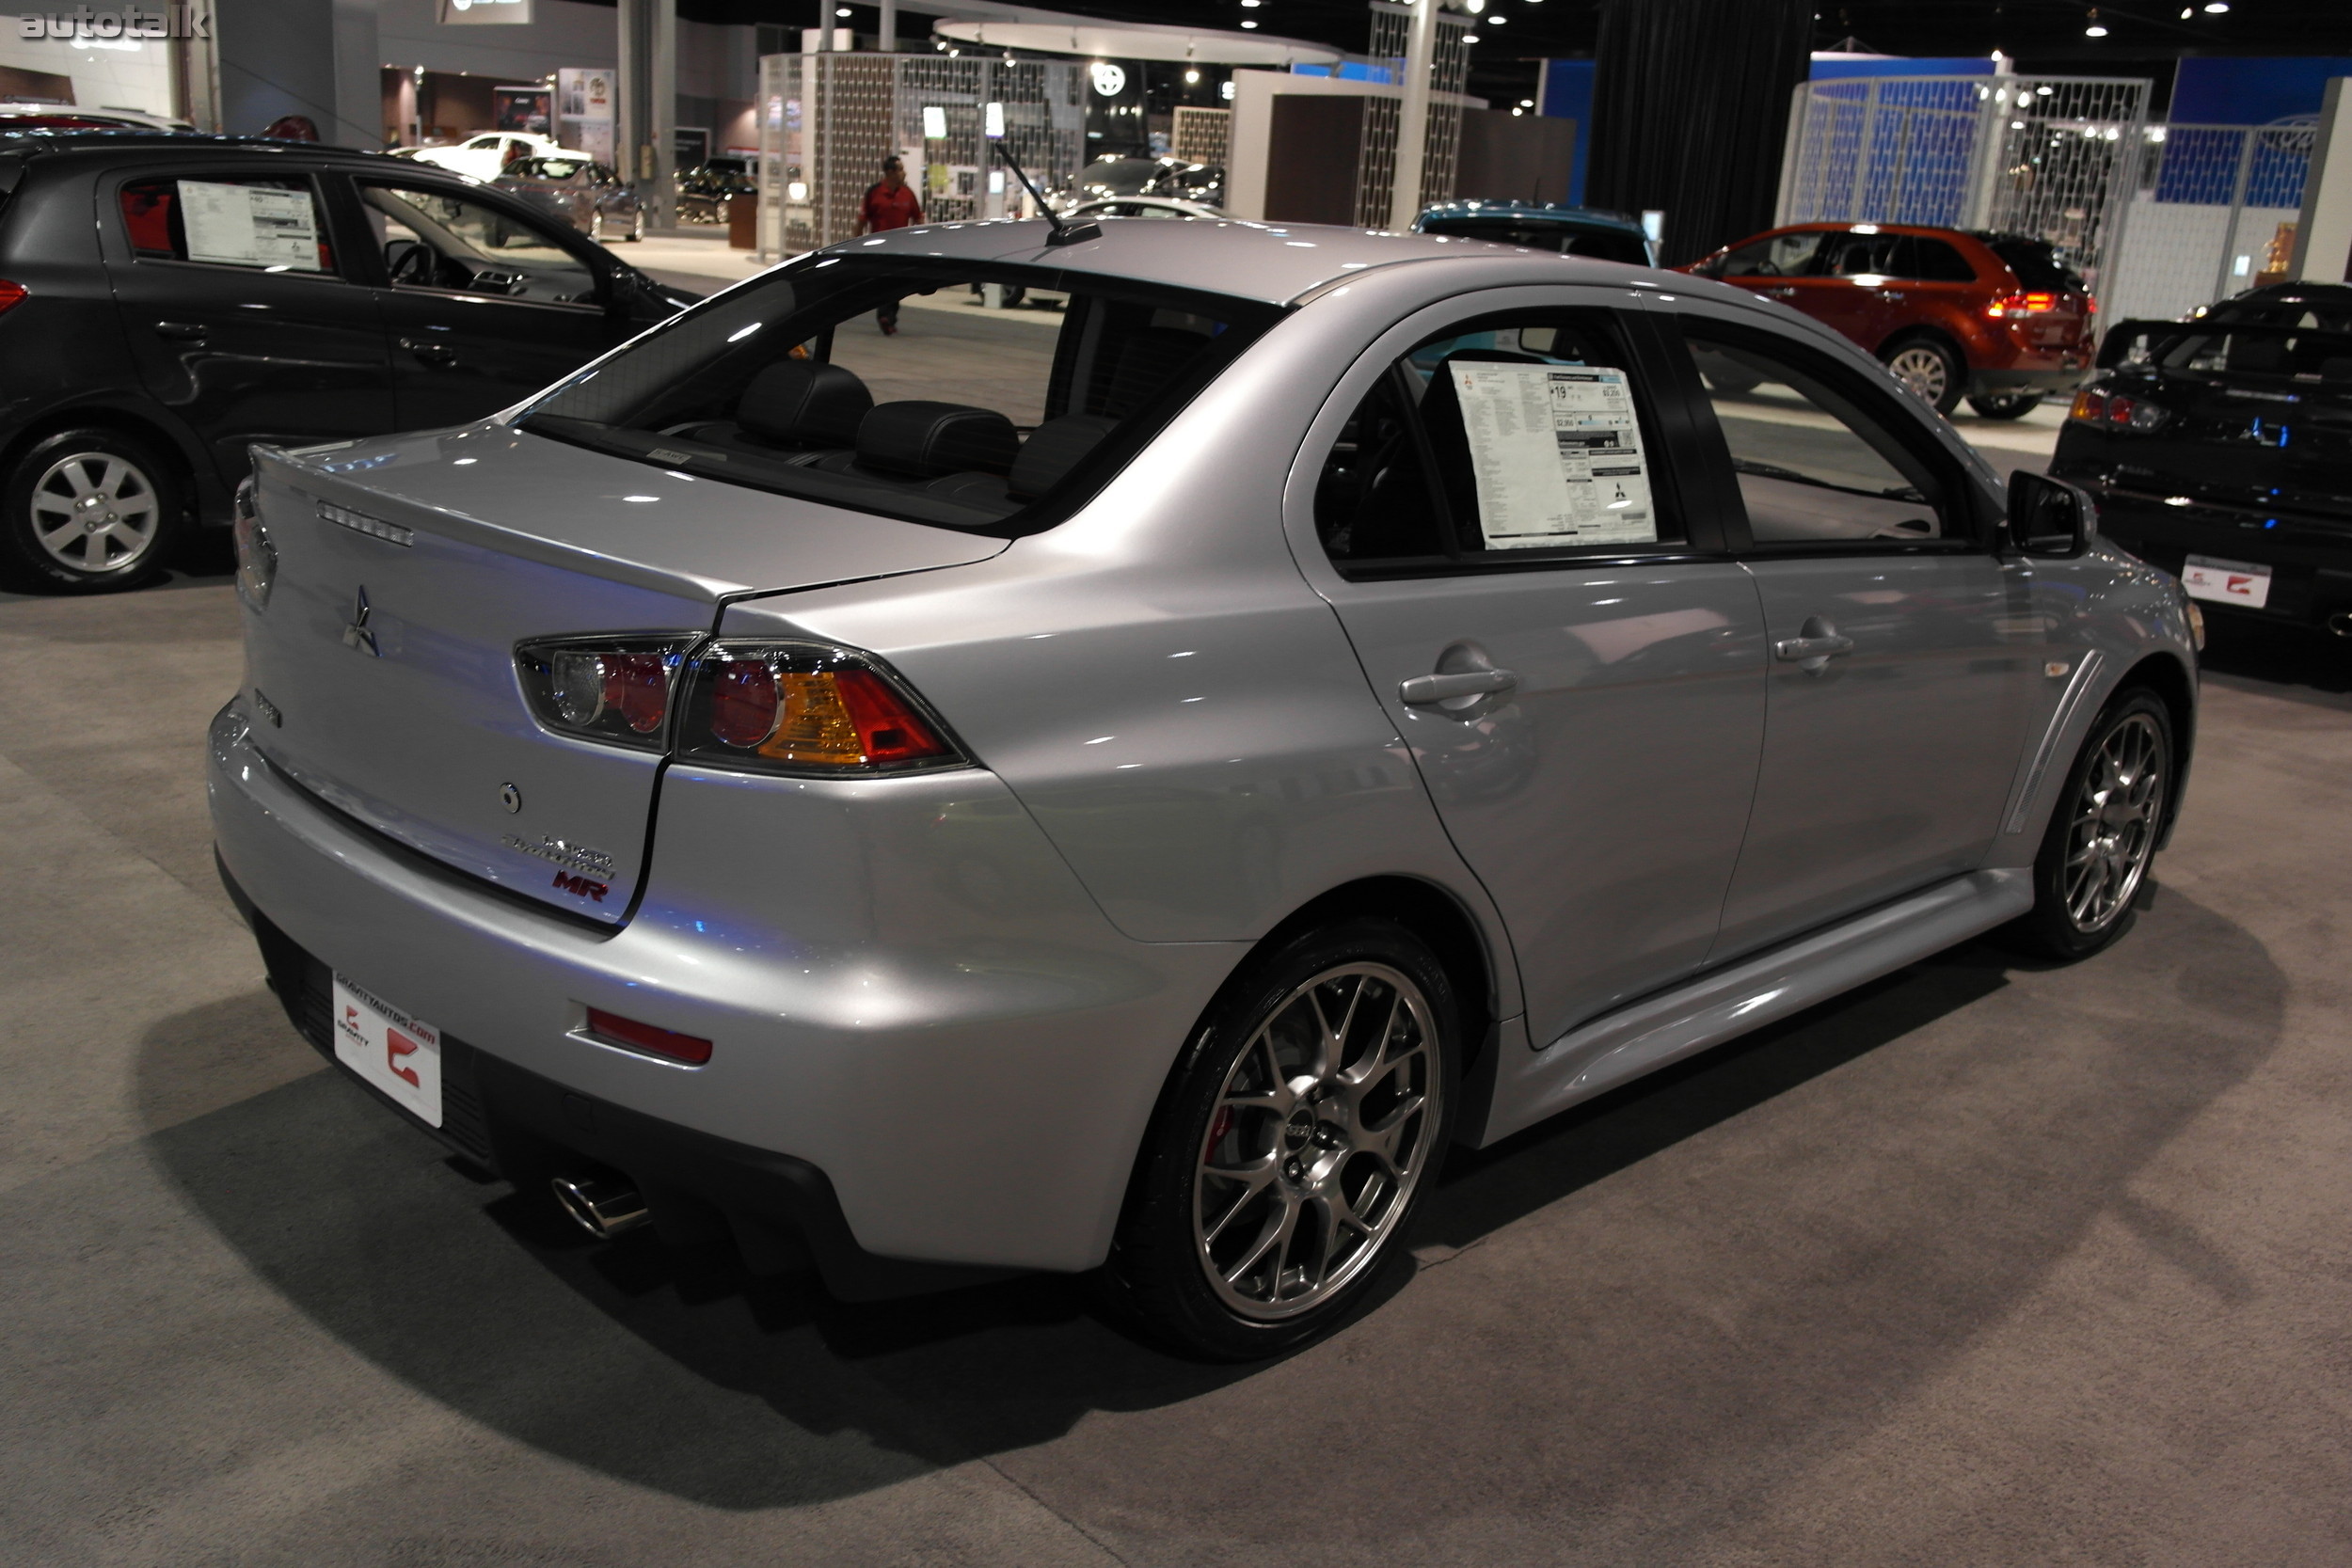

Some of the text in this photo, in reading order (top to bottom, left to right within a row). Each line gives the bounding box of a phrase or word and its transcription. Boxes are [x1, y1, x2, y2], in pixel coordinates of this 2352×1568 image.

[1555, 386, 1566, 399] 19
[552, 869, 609, 902] MR
[337, 1019, 370, 1047] GRAVITY
